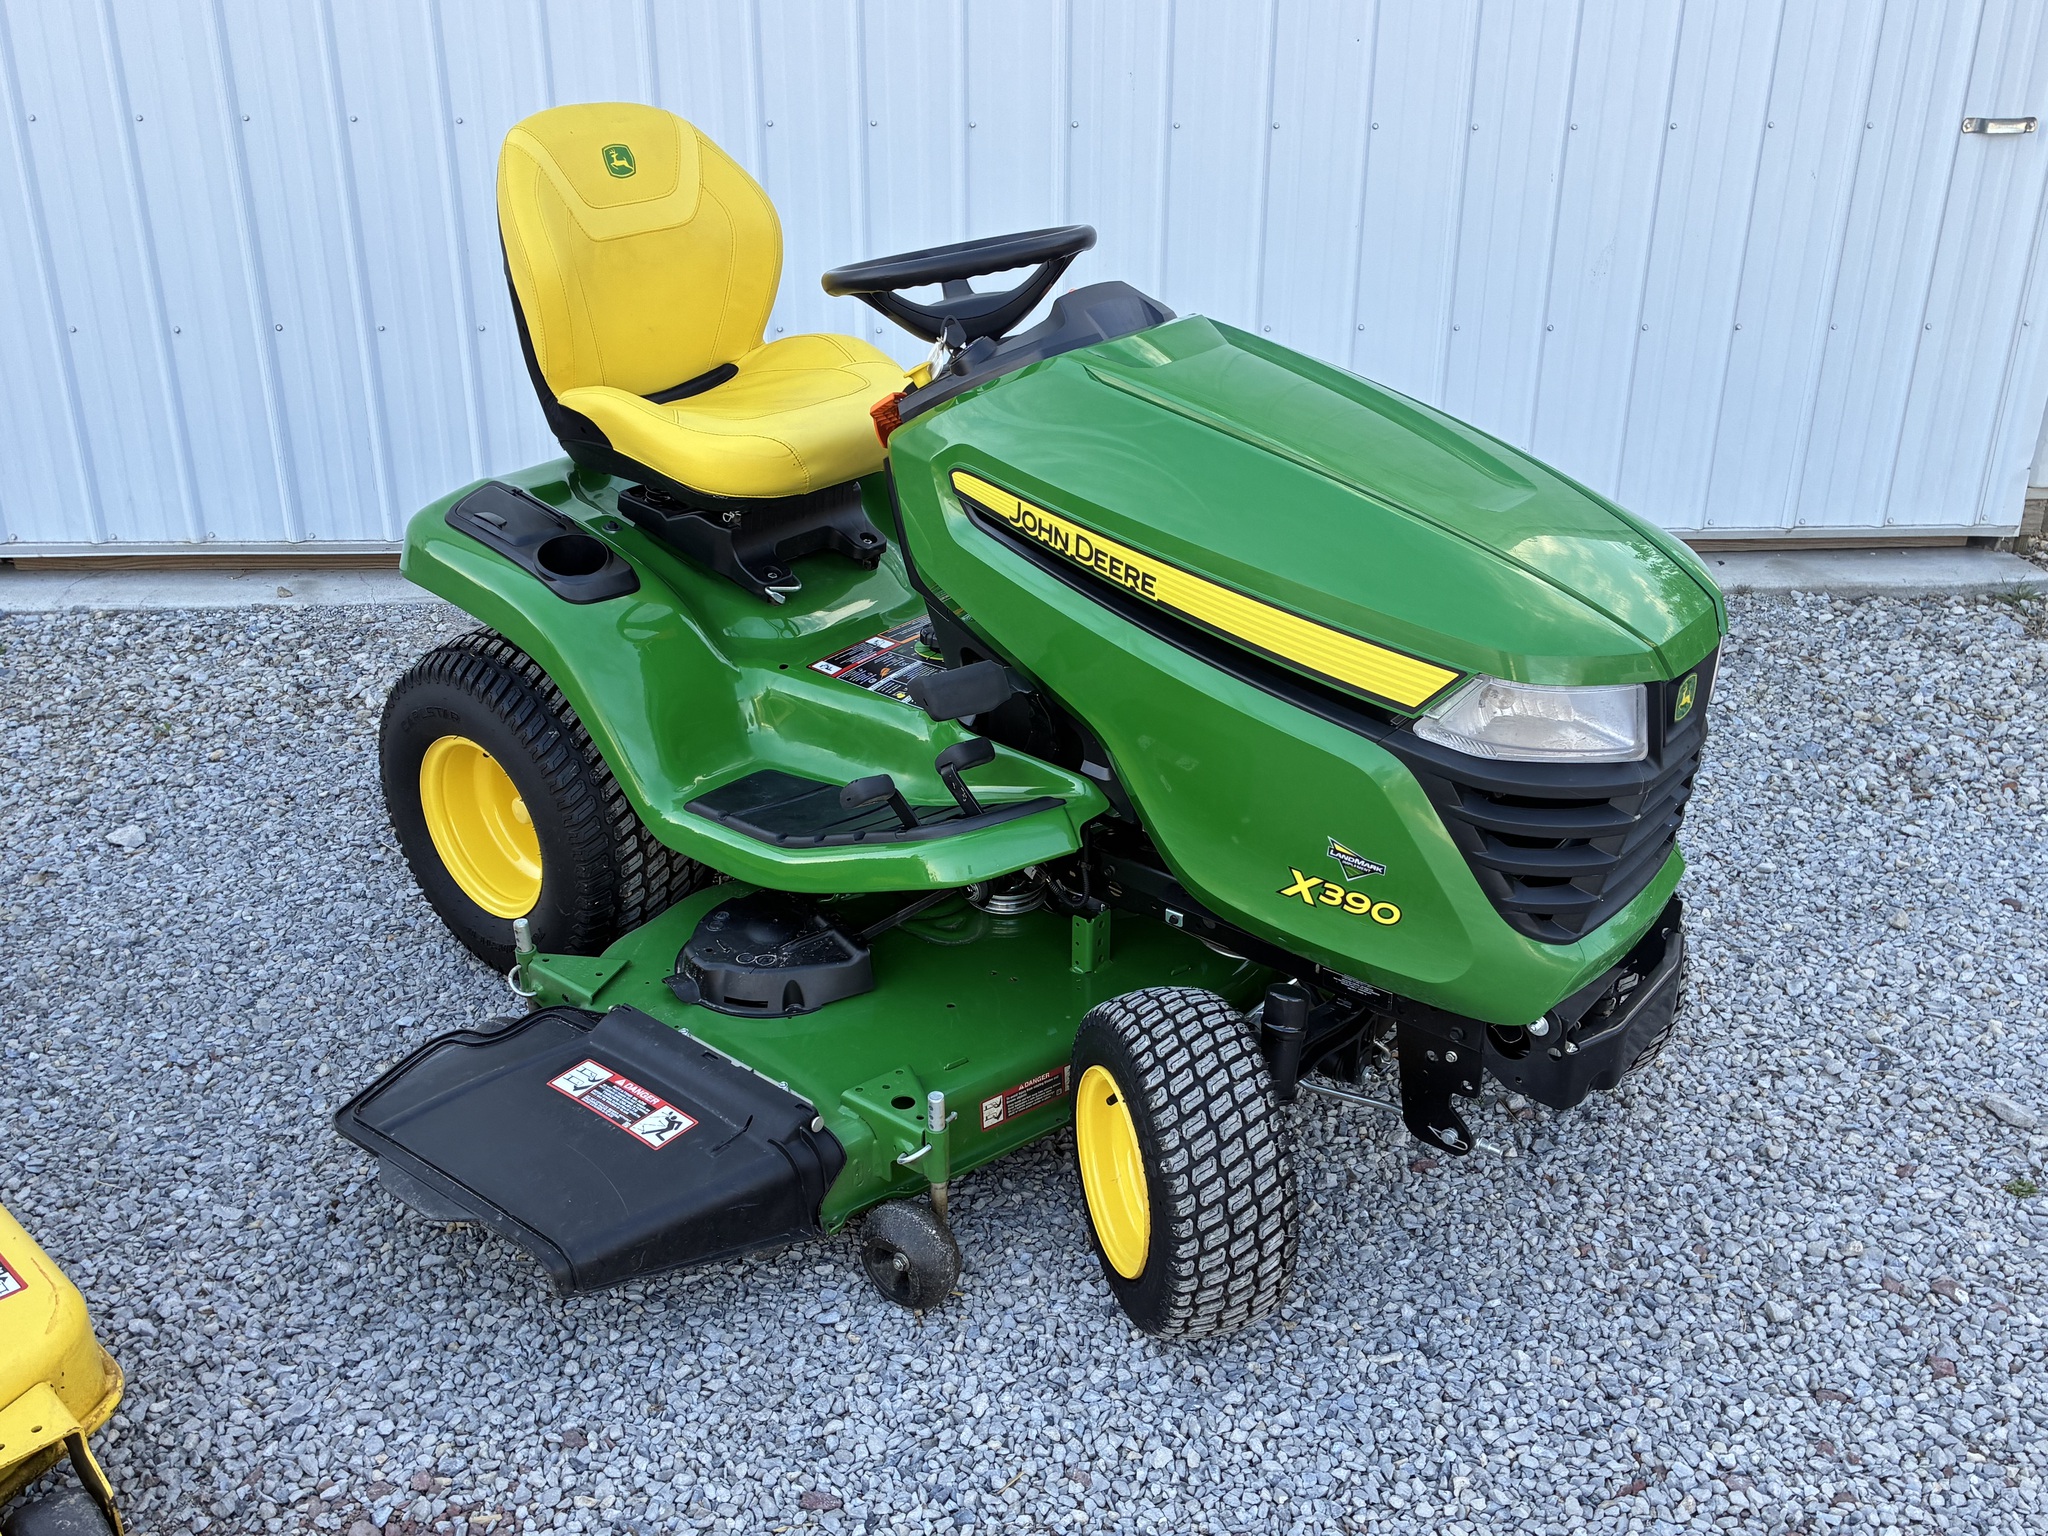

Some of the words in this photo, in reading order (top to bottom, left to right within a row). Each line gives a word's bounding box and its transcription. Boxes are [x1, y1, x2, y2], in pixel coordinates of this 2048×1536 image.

[1009, 501, 1070, 553] JOHN
[1075, 533, 1157, 598] DEERE
[1329, 849, 1384, 873] LANDMARK
[1277, 867, 1401, 926] X390
[1024, 1072, 1050, 1089] DANGER
[623, 1082, 661, 1105] DANGER
